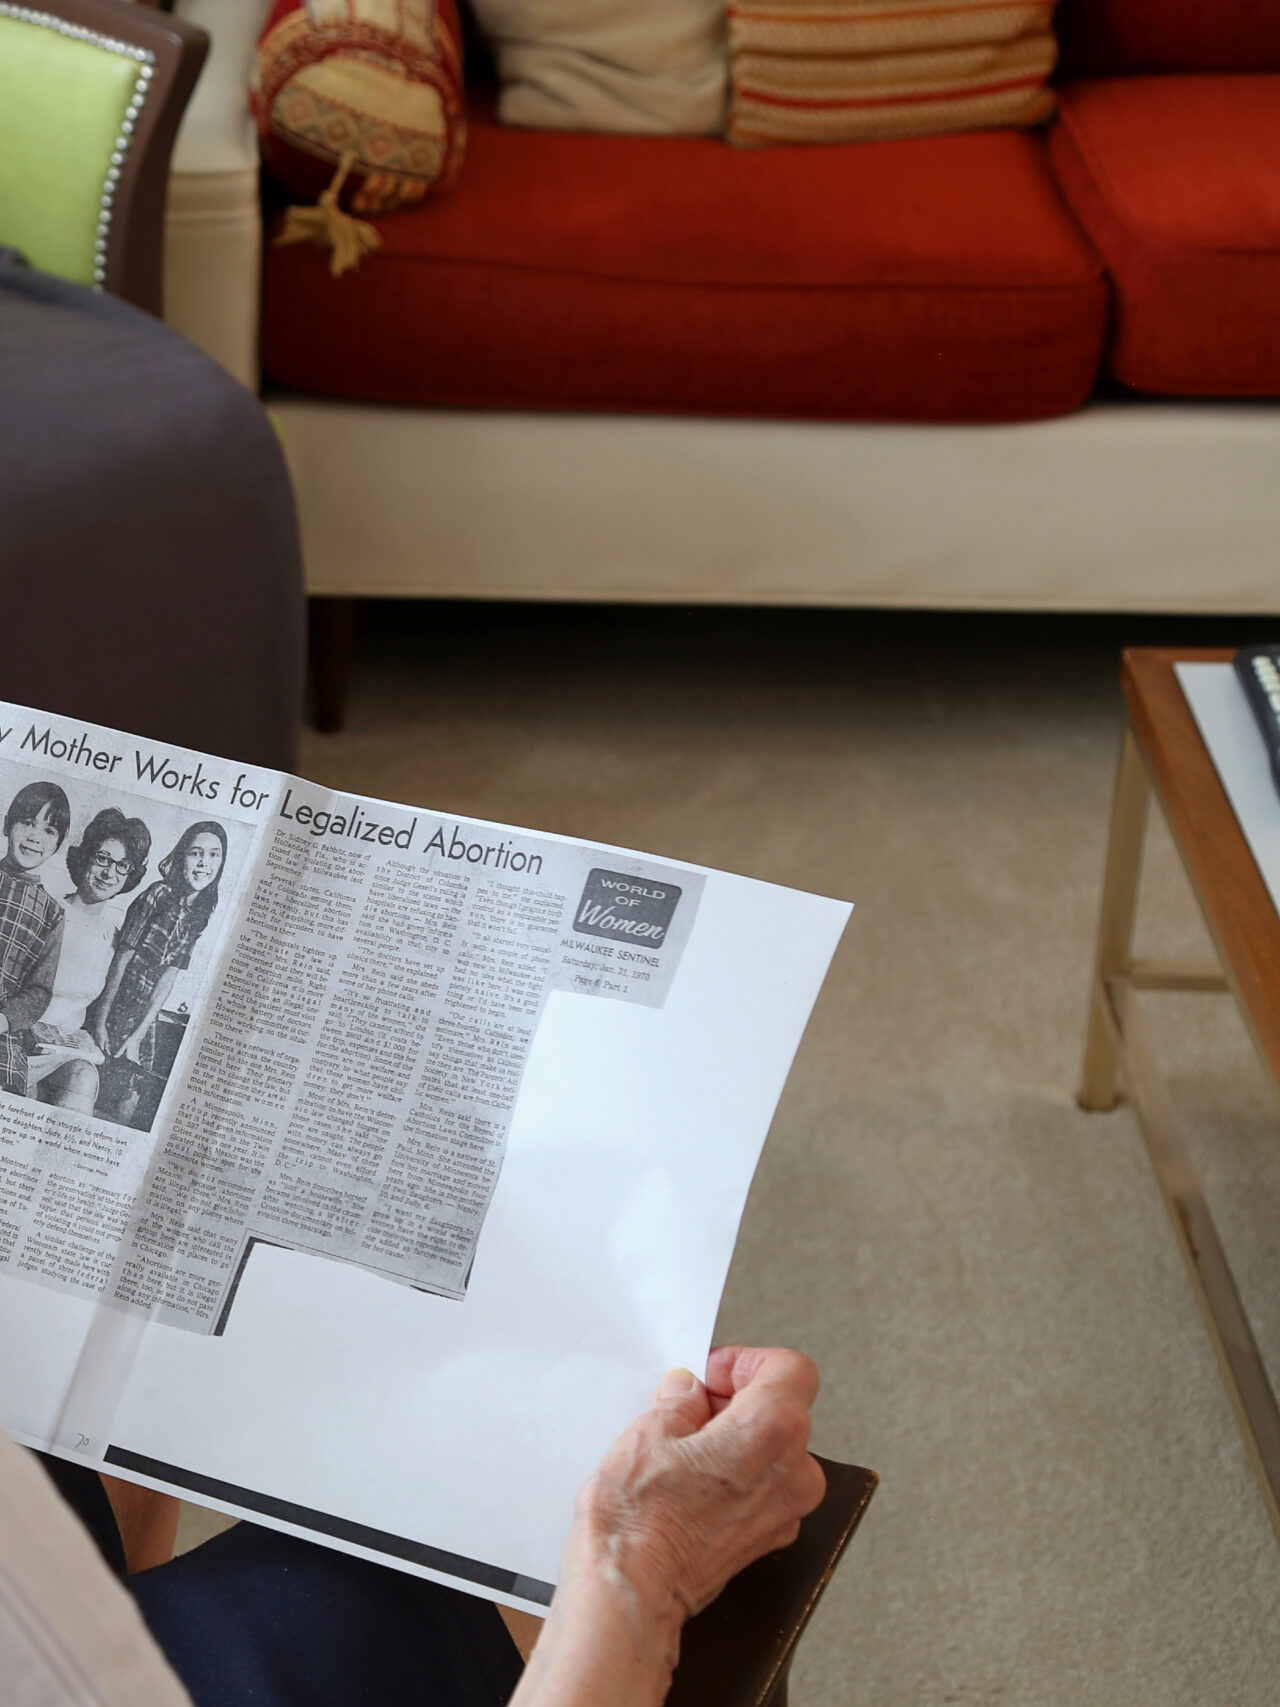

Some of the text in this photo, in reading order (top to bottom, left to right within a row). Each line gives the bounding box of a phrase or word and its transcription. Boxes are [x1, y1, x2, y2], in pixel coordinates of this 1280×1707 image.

[20, 724, 122, 772] Mother
[135, 750, 219, 799] Works
[230, 774, 269, 810] for
[279, 788, 416, 848] Legalized
[422, 825, 542, 874] Abortion
[268, 851, 363, 884] tion law in Milwaukee last
[600, 878, 665, 899] WORLD
[614, 895, 641, 906] OF
[245, 916, 279, 932] abortions
[577, 899, 664, 939] Women
[269, 935, 299, 950] hospitals
[301, 945, 325, 957] tighten
[328, 953, 337, 961] up
[559, 939, 659, 967] MILWAUKEE SENTINEL
[228, 965, 244, 974] now
[245, 969, 253, 979] in
[255, 974, 288, 989] California
[298, 985, 305, 993] is
[306, 989, 324, 998] more
[338, 977, 356, 986] some
[364, 983, 377, 991] her
[376, 987, 397, 997] phone
[631, 970, 650, 981] 1970
[0, 1113, 11, 1123] two
[7, 1104, 34, 1118] forefront
[45, 1116, 56, 1125] the
[57, 1121, 82, 1132] struggle
[84, 1127, 91, 1136] to
[92, 1131, 113, 1142] reform
[1, 1126, 17, 1134] grow
[18, 1131, 27, 1139] up
[44, 1140, 62, 1149] world
[63, 1144, 80, 1155] where
[83, 1151, 104, 1161] women
[105, 1156, 120, 1167] have
[402, 1124, 414, 1132] the
[414, 1127, 448, 1141] formation
[449, 1137, 468, 1148] stage
[0, 1155, 28, 1169] Montreal
[31, 1166, 42, 1174] are
[281, 1144, 377, 1176] women cannot even afford
[8, 1169, 38, 1183] abortions
[387, 1166, 488, 1200] here from Minneapolis four
[11, 1231, 18, 1239] in
[32, 1218, 45, 1228] erly
[45, 1222, 67, 1234] defend
[124, 1260, 145, 1272] erally
[148, 1269, 178, 1282] available
[192, 1281, 219, 1295] Chicago
[113, 1290, 130, 1301] Rein
